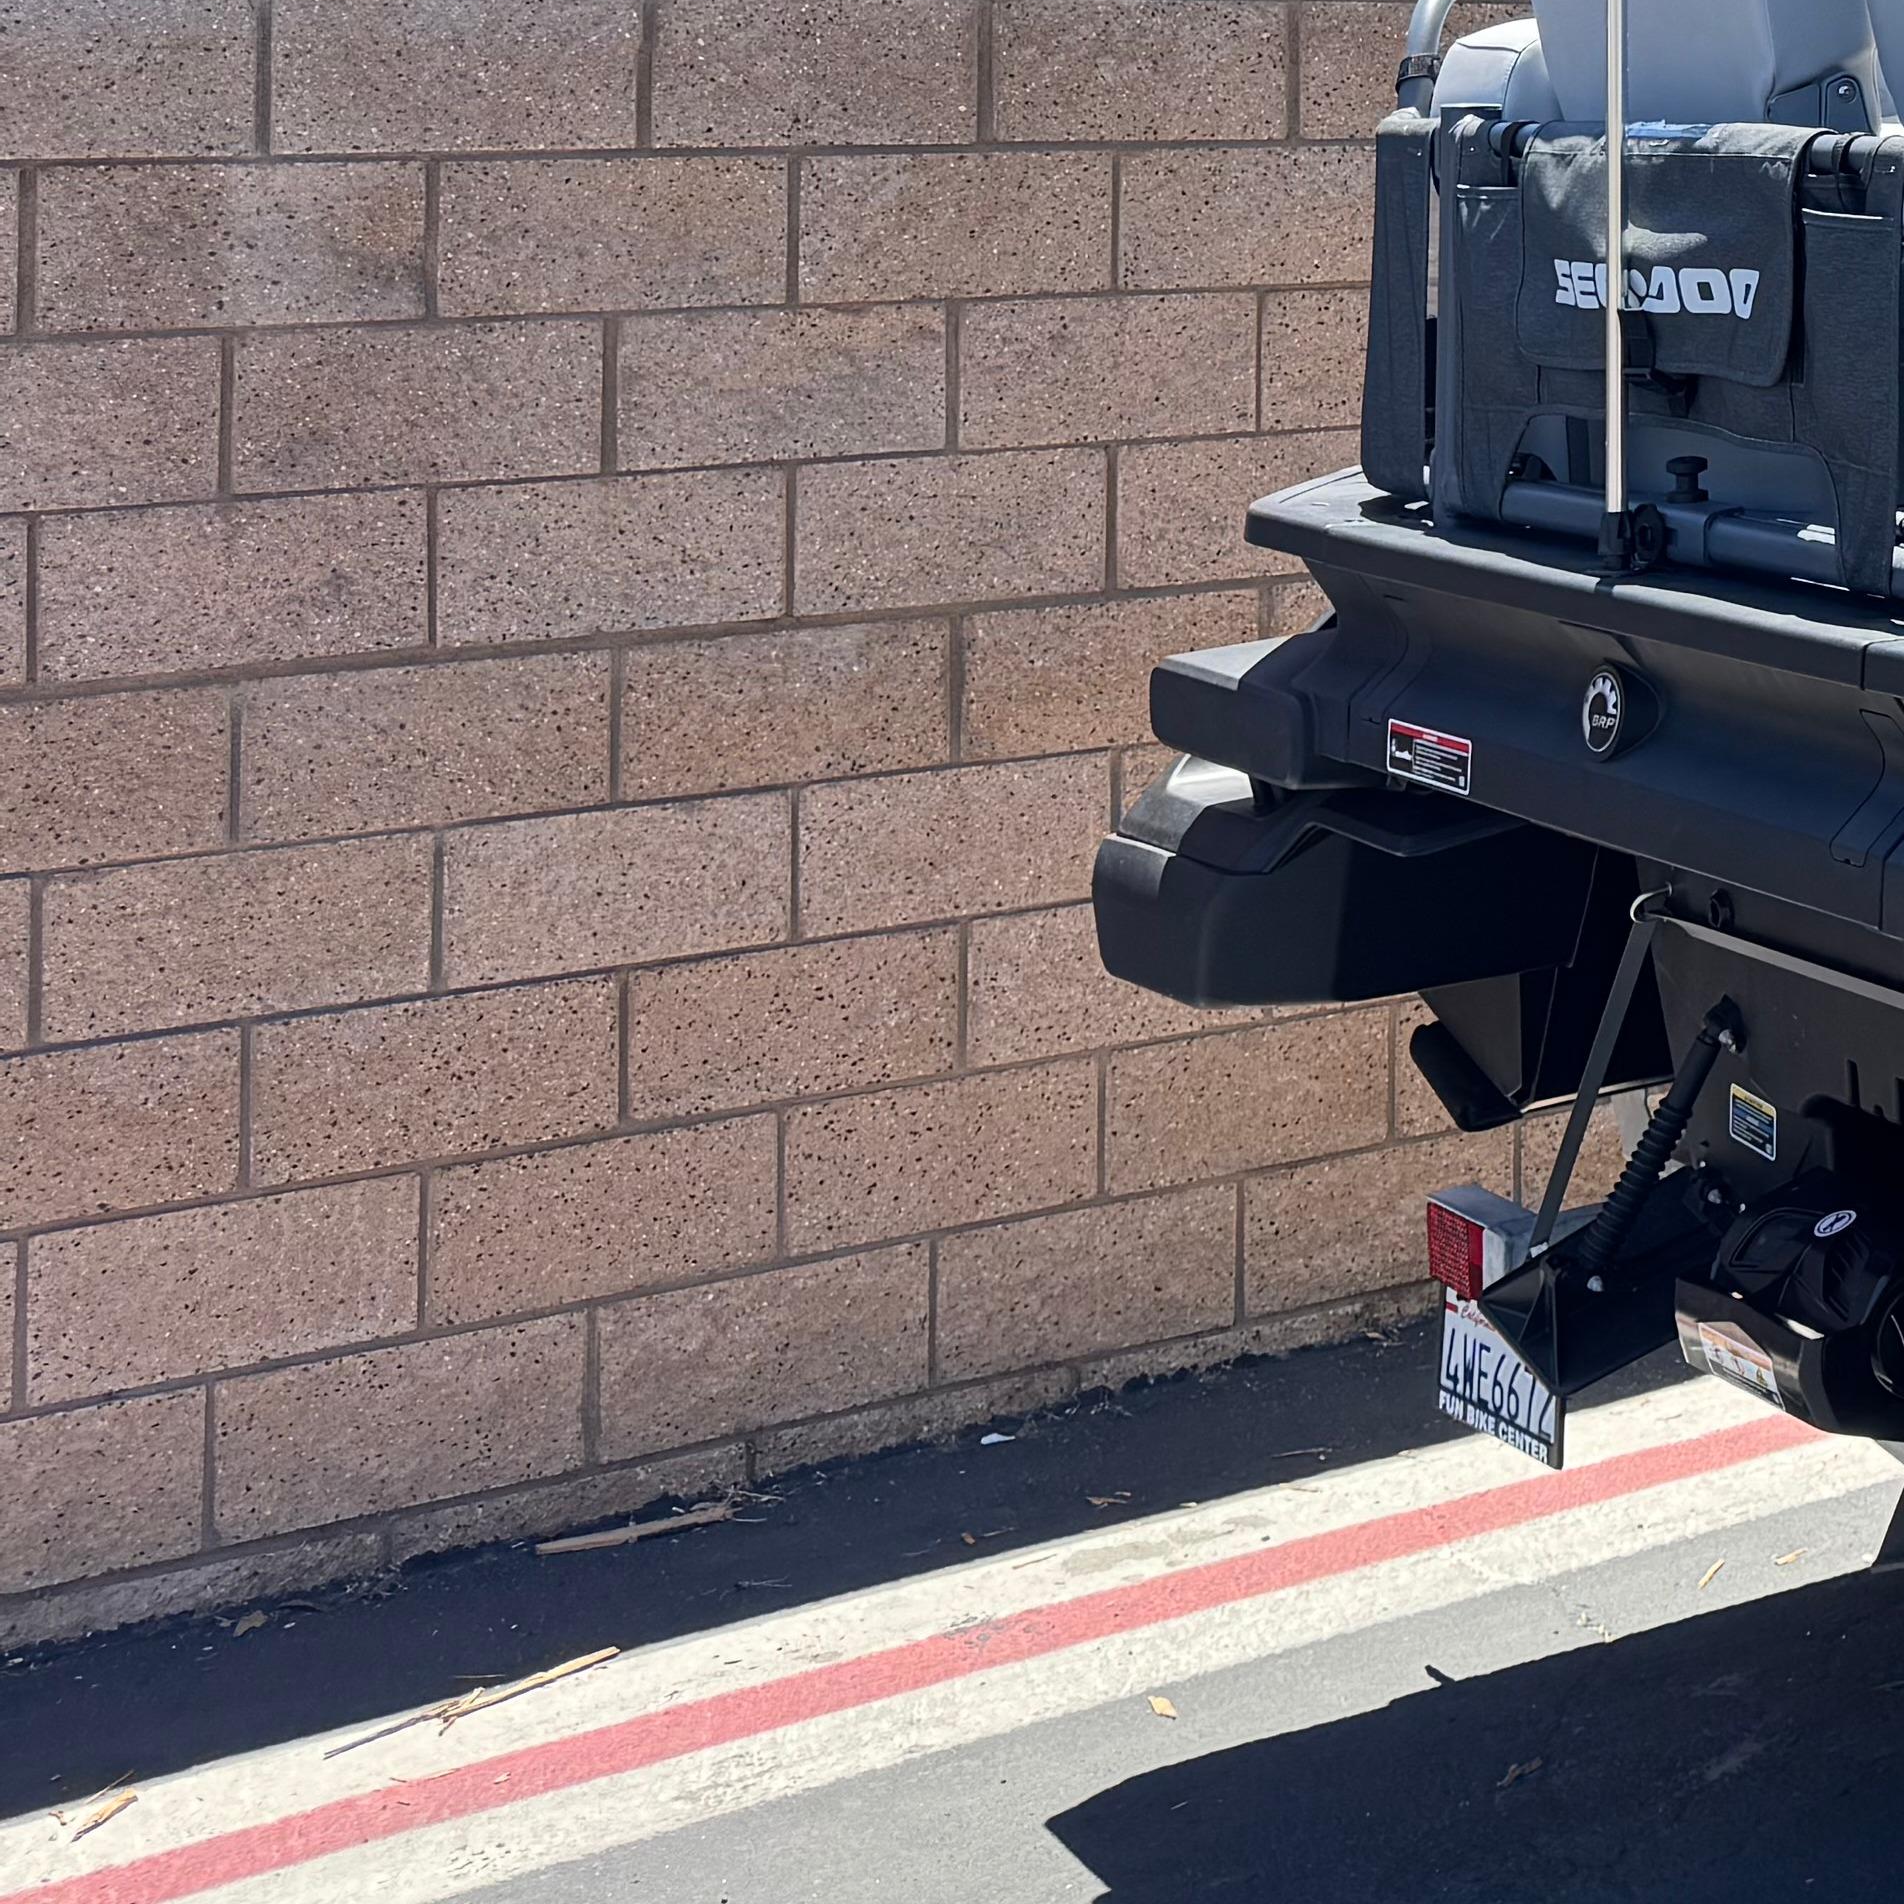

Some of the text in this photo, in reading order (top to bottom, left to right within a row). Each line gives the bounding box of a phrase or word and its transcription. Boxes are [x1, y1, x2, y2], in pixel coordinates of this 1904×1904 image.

[1592, 714, 1615, 729] BRP
[1439, 1390, 1548, 1464] FUN BIKE CENTER
